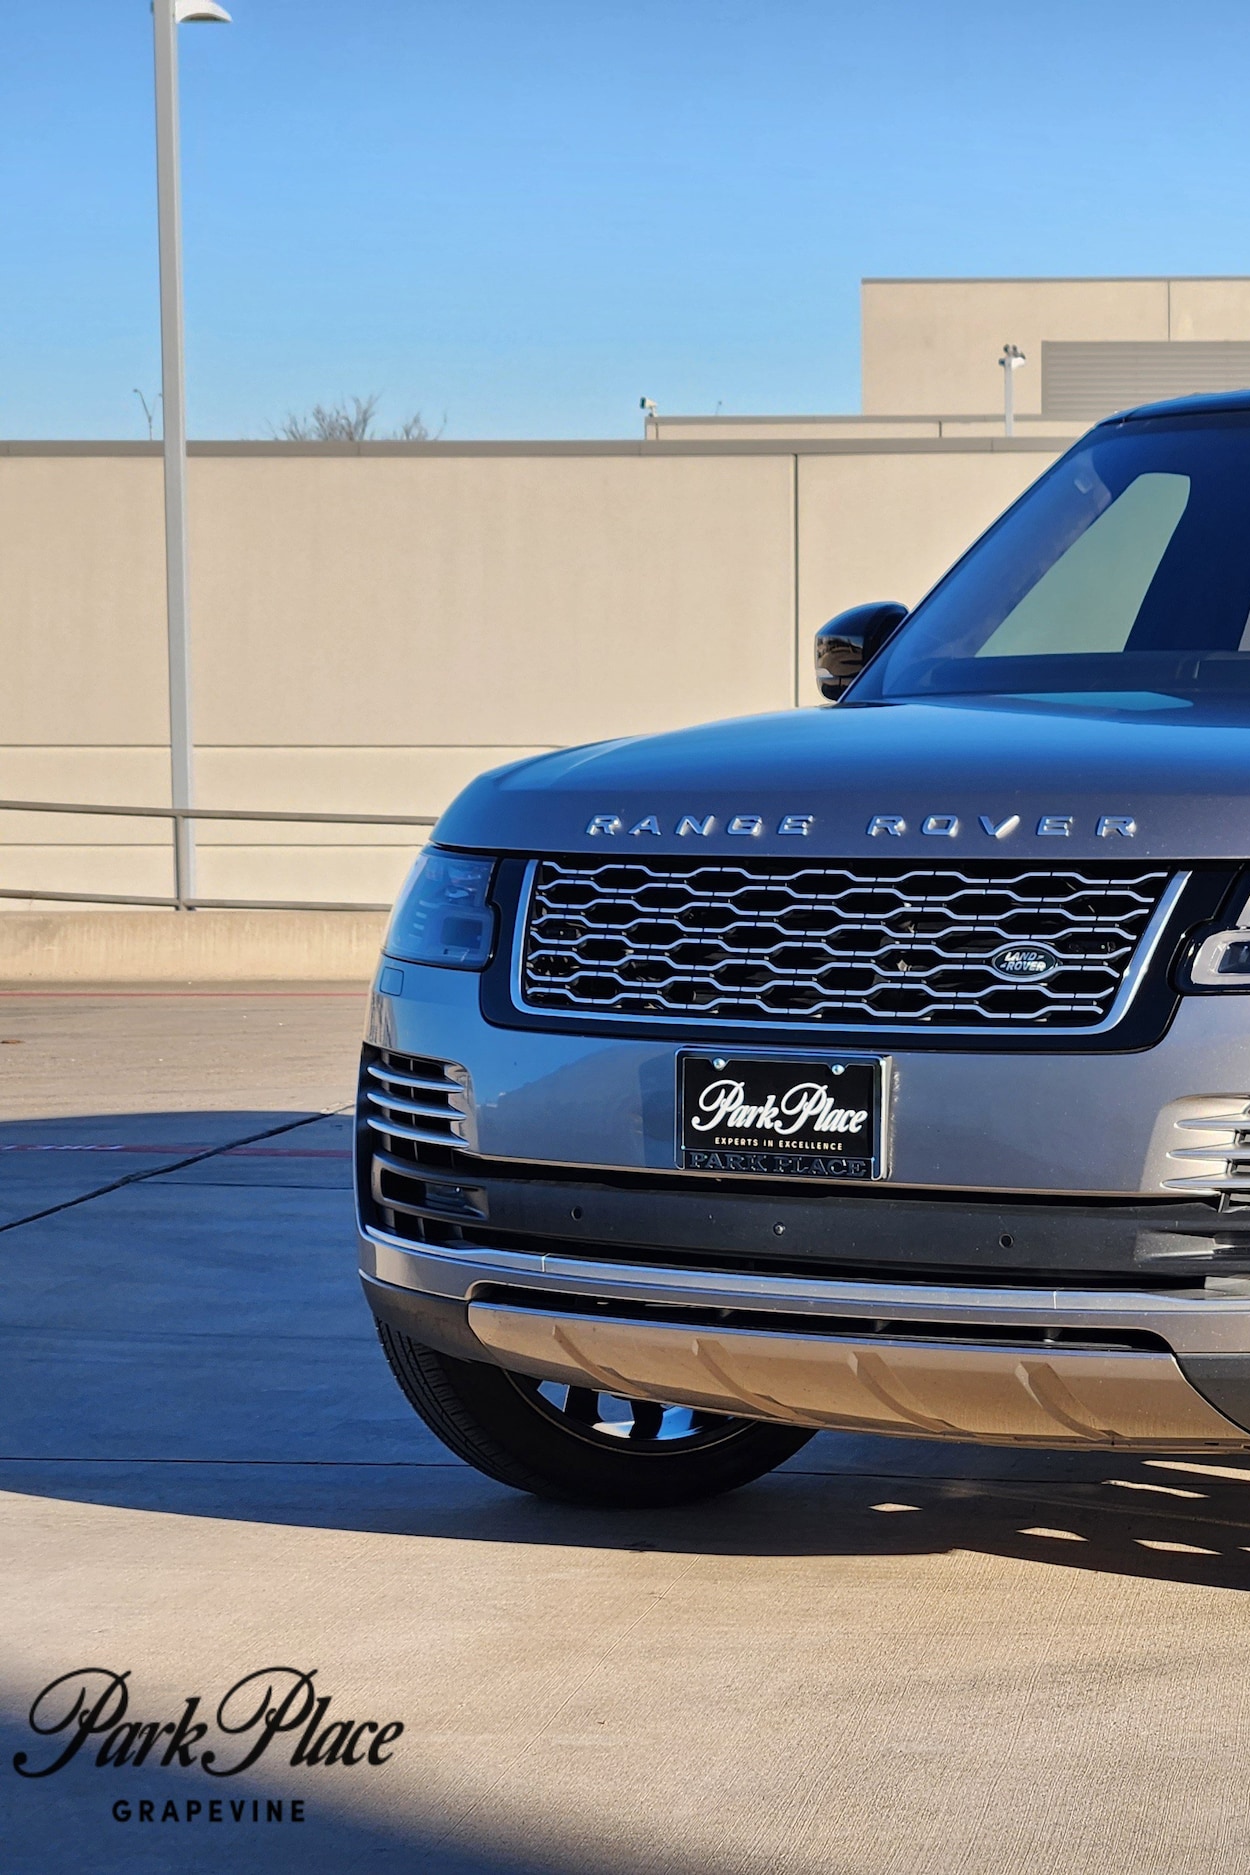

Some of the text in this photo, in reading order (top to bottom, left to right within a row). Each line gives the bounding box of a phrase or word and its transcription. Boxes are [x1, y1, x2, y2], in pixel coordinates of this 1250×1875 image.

[586, 814, 1137, 838] RANGE ROVER
[1005, 960, 1047, 972] ROVER
[691, 1079, 868, 1136] Park Place
[714, 1136, 843, 1151] EXPERTS IN EXCELLENCE
[689, 1151, 868, 1177] PARK PLACE
